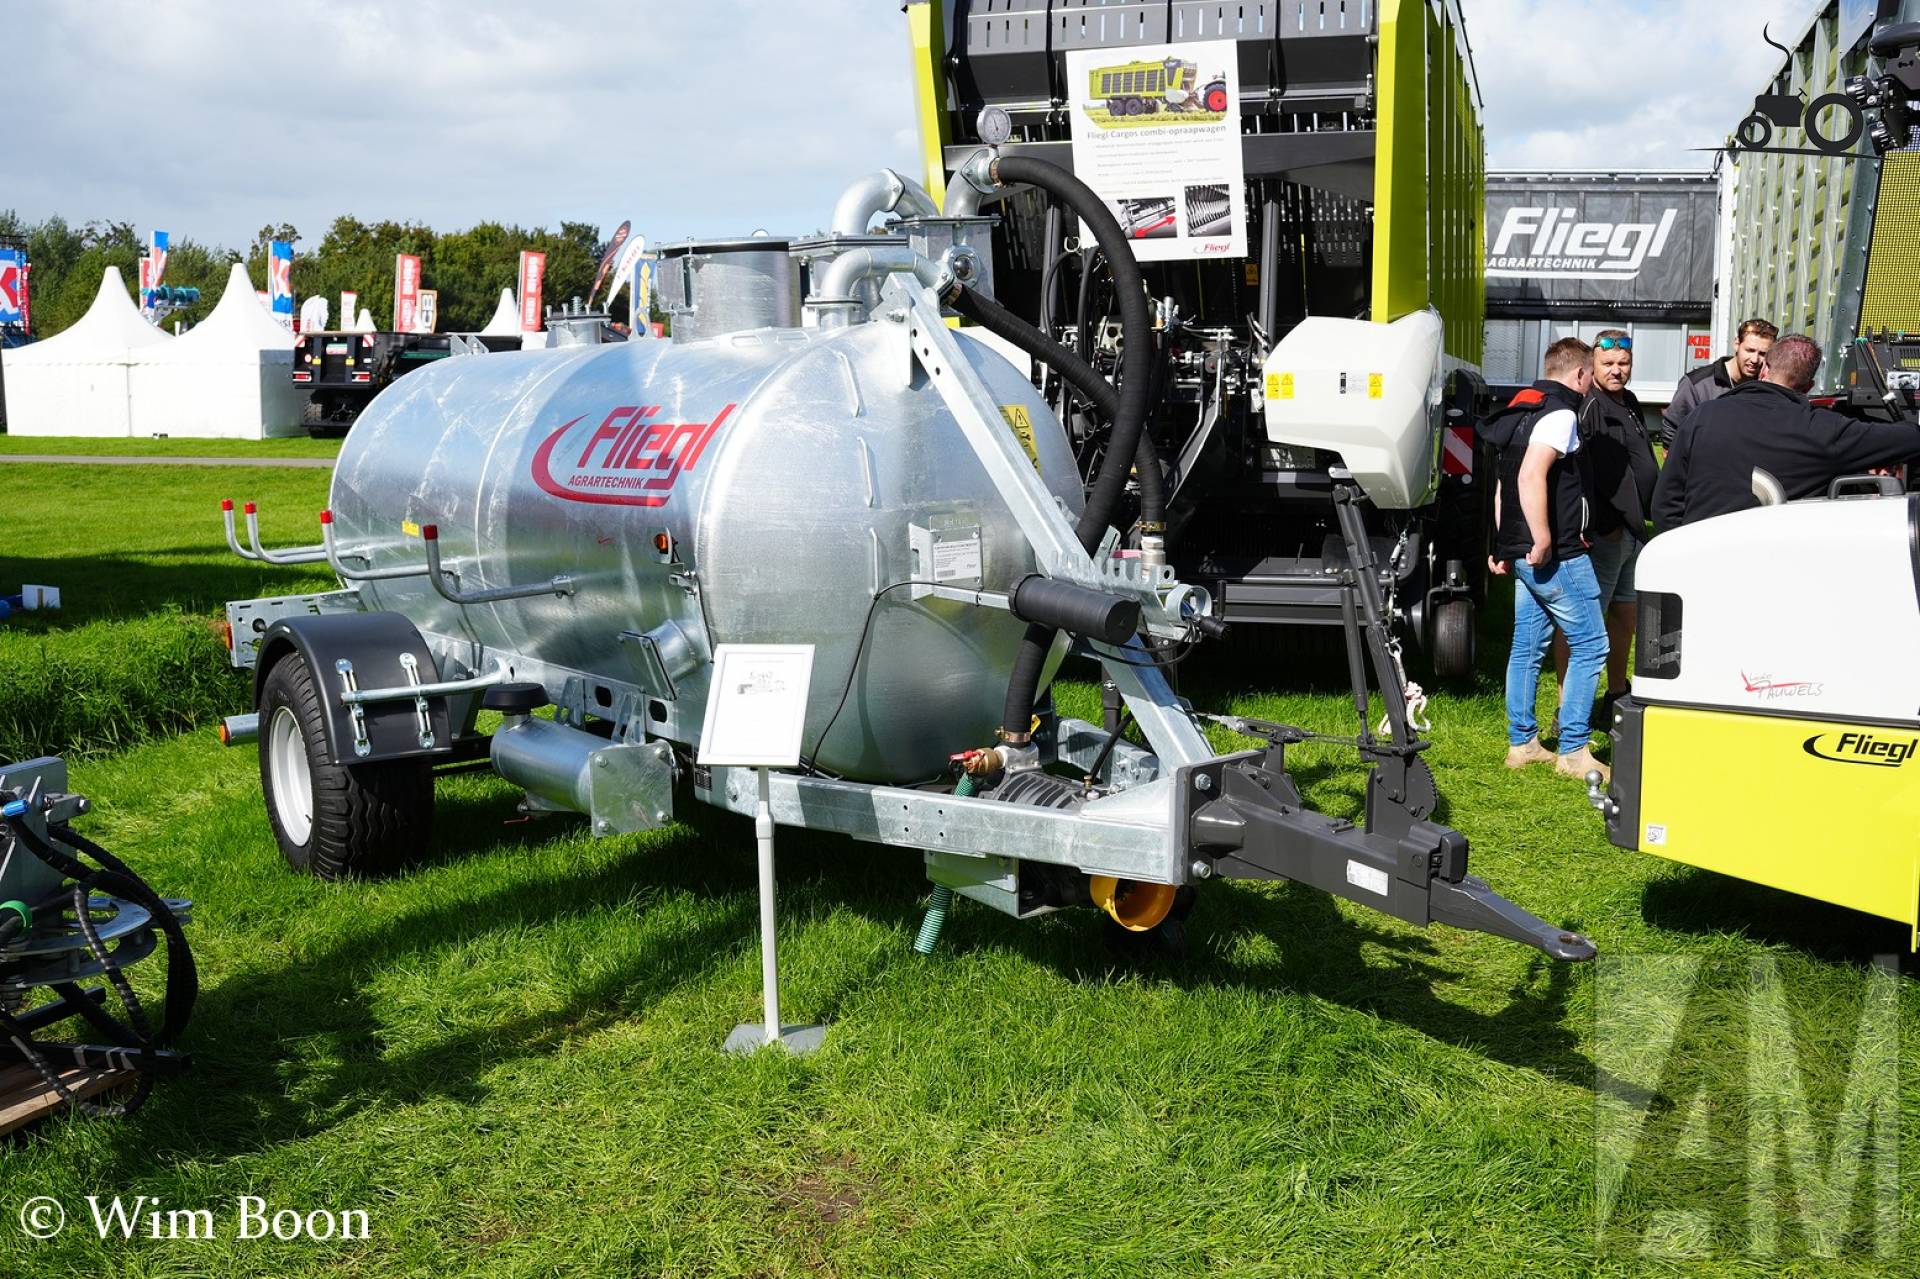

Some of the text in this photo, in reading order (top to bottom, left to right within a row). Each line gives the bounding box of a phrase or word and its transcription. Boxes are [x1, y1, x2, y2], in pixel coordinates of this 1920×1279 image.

[1492, 207, 1678, 269] Fliegl
[1488, 257, 1599, 269] AGRARTECHNIK
[577, 403, 737, 490] Fliegl
[567, 474, 644, 489] AGRARTECHNIK
[1836, 732, 1919, 763] Fliegl
